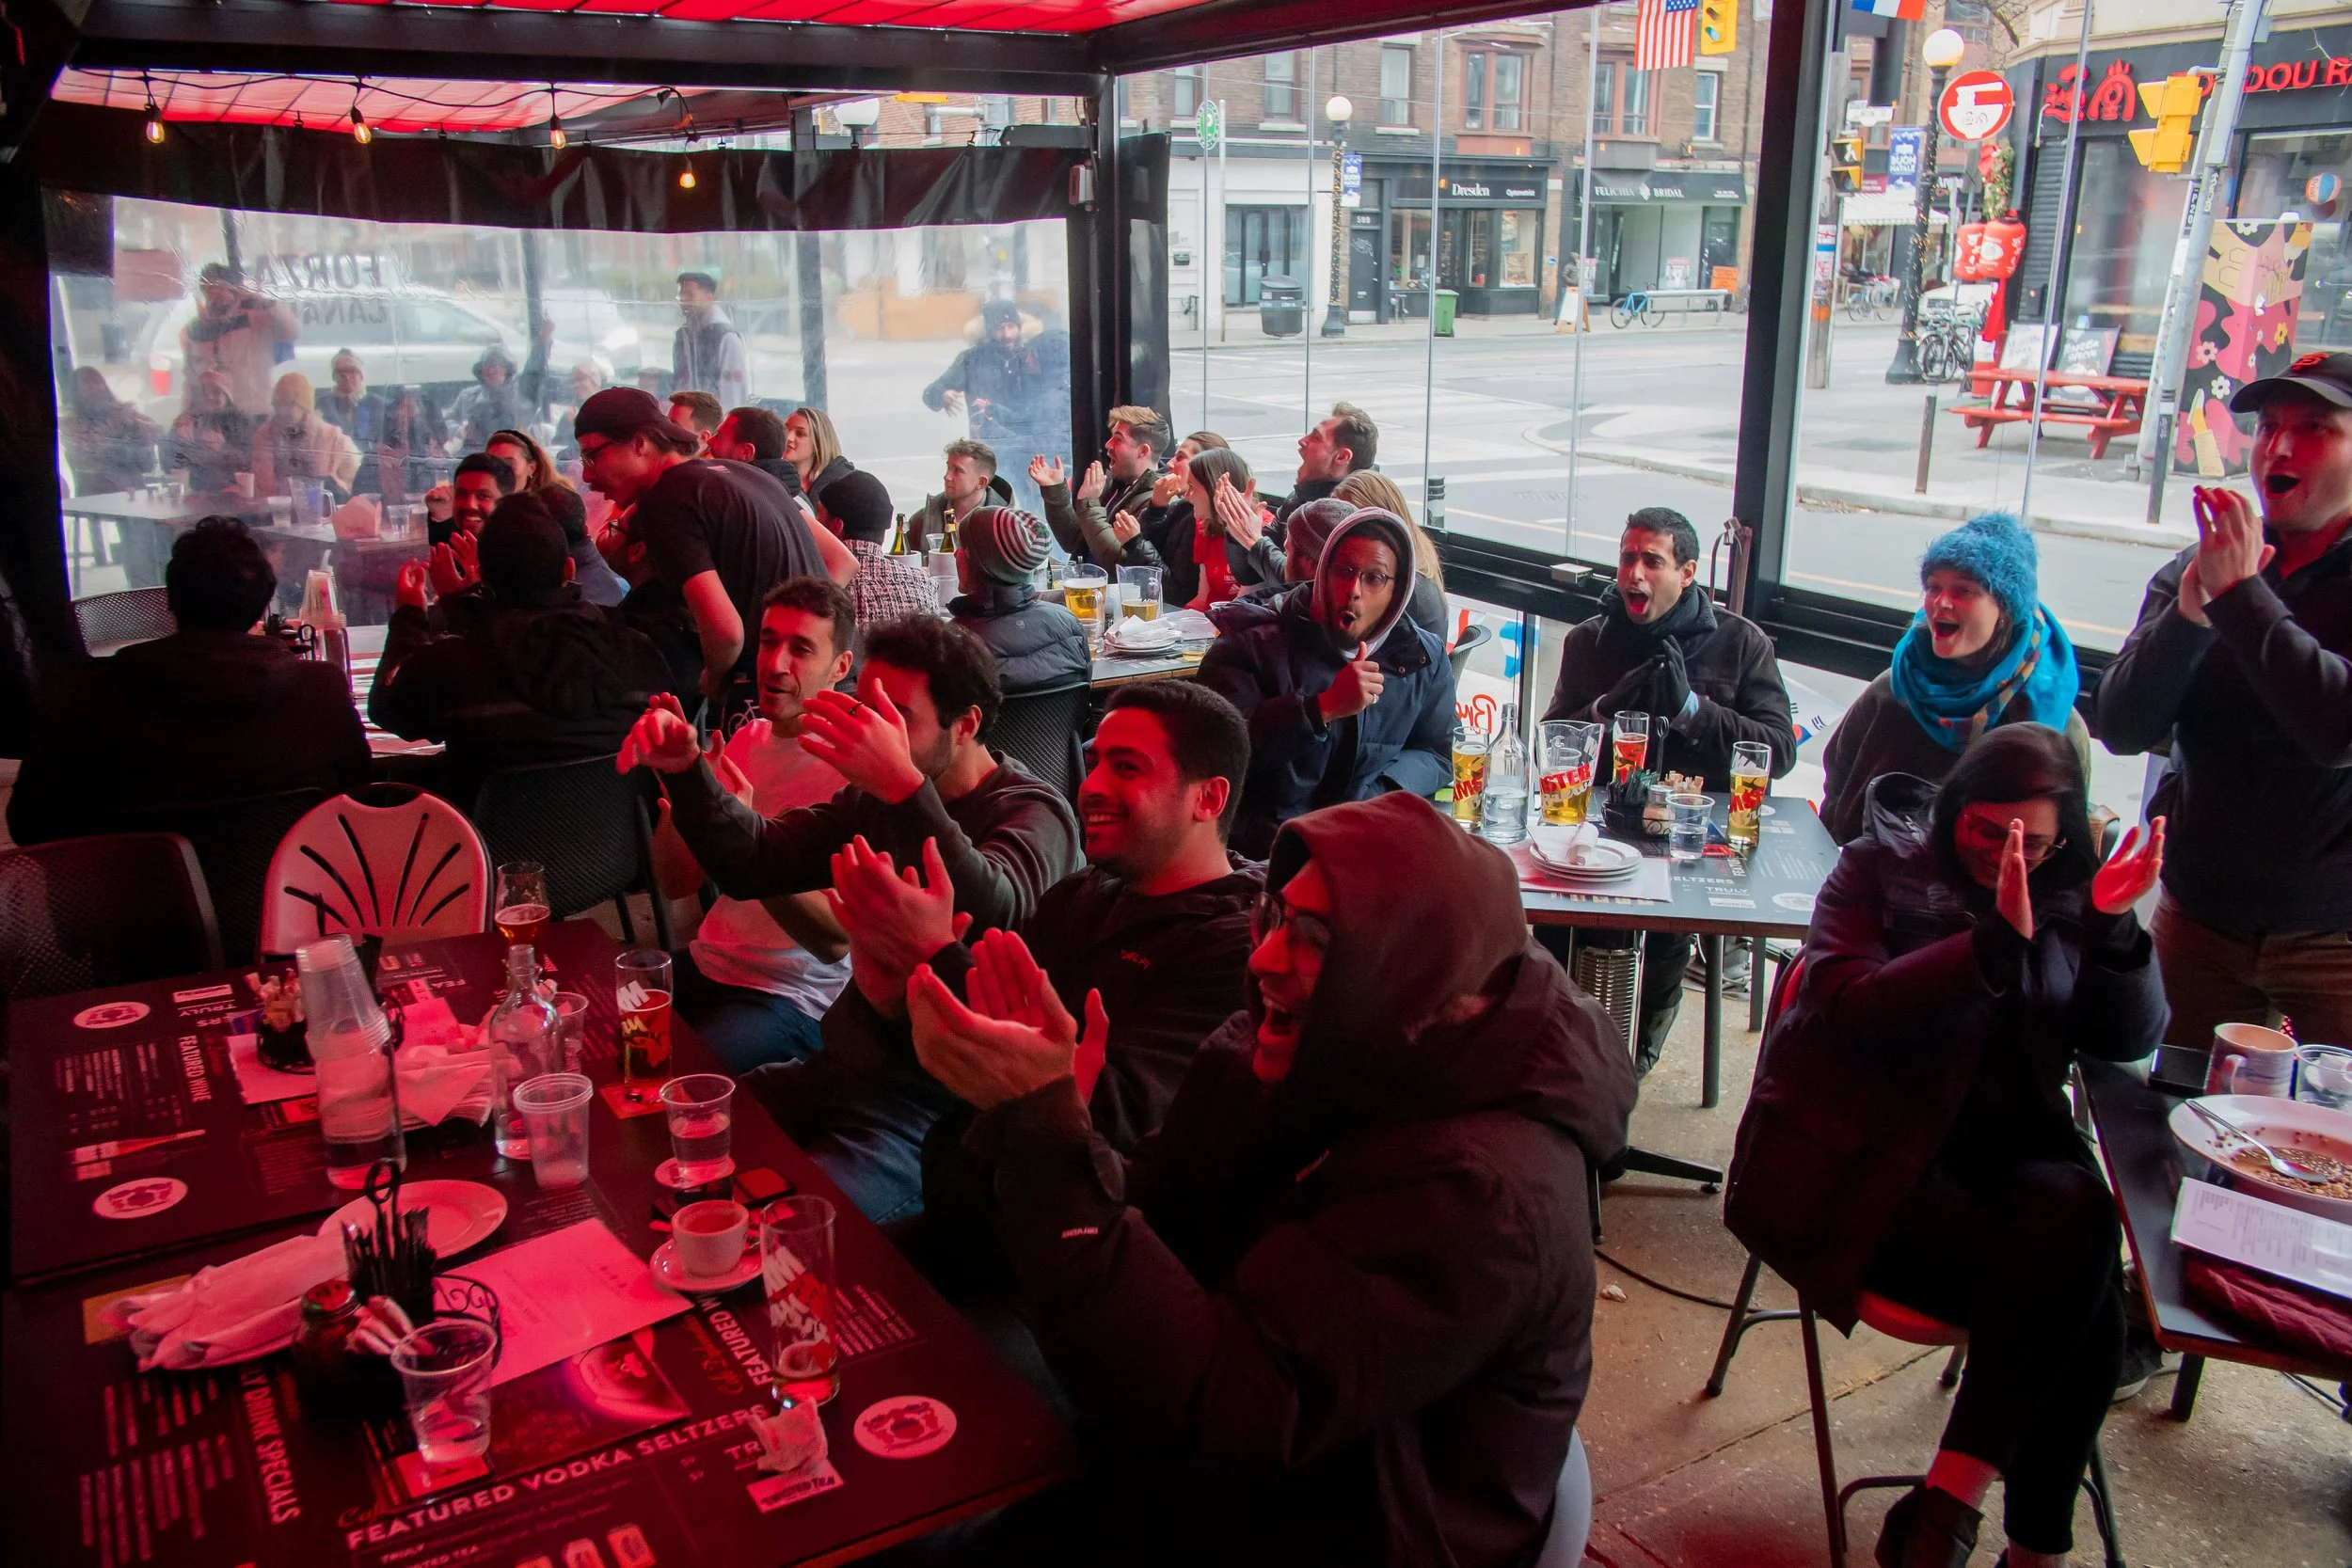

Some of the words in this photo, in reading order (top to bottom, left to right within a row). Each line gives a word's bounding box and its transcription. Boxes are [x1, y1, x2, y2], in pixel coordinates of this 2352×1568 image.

[1452, 183, 1490, 197] Dresden
[1653, 187, 1685, 198] BRIDAL
[1671, 876, 1735, 885] ELTZERS
[179, 1035, 205, 1078] FEATURED
[189, 1077, 213, 1103] WINE
[709, 1310, 774, 1386] FEATURED
[243, 1386, 281, 1442] DRINK
[255, 1438, 301, 1526] SPECIALS
[346, 1484, 516, 1551] FEATURED
[520, 1449, 634, 1491] VODKA
[640, 1403, 769, 1458] SELTZERS
